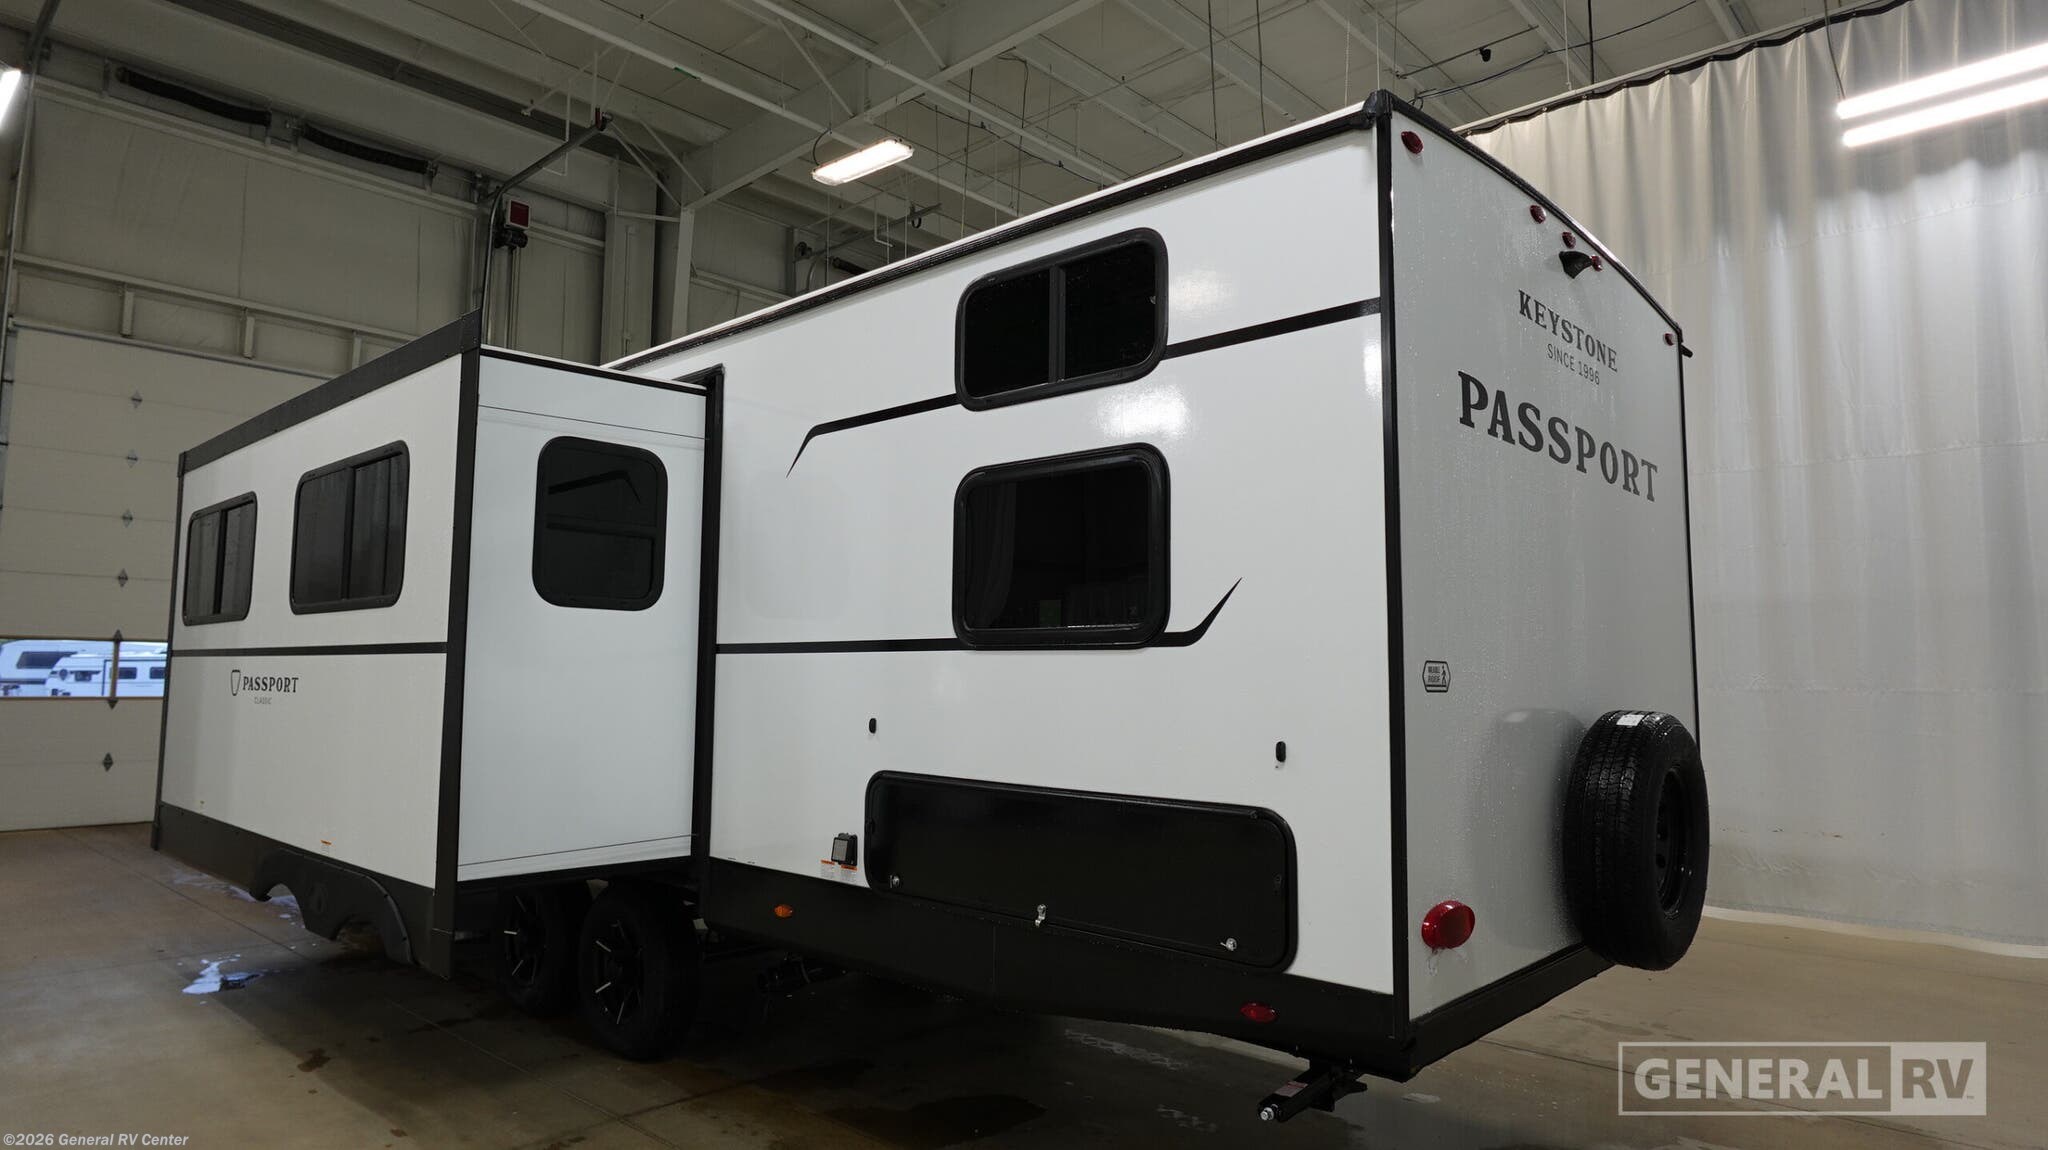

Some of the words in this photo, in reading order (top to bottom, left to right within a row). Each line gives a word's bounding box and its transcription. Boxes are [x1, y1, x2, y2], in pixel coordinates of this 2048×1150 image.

[1518, 289, 1618, 373] KEYSTONE
[1546, 343, 1575, 372] SINCE
[1578, 361, 1600, 386] 1996
[1457, 370, 1658, 502] PASSPORT
[242, 675, 299, 693] PASSPORT
